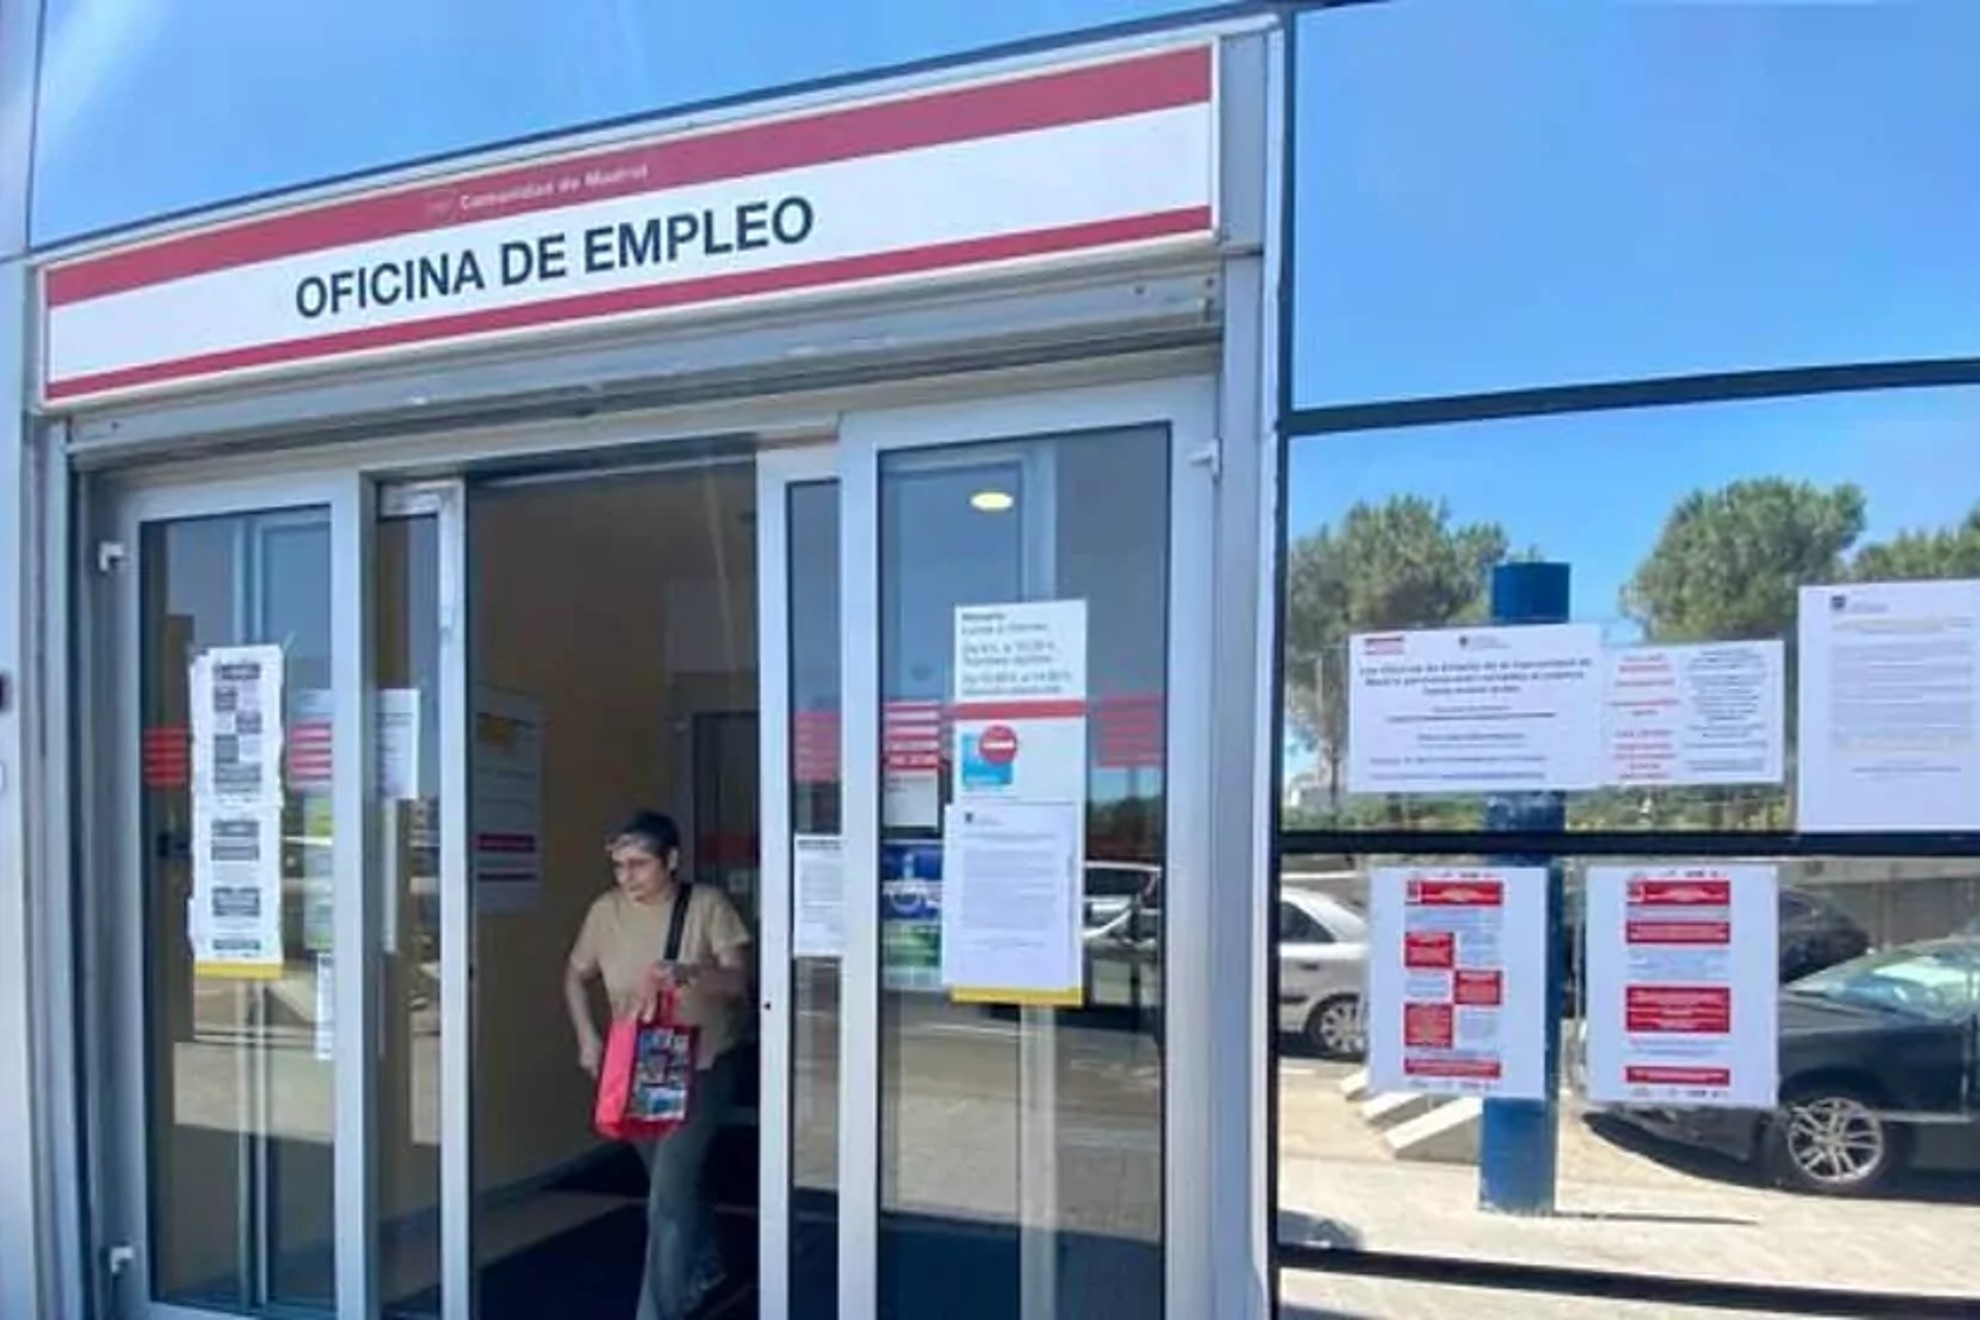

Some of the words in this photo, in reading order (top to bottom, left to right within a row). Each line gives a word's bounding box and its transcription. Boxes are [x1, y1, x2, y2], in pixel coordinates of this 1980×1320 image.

[295, 249, 486, 318] OFICINA
[501, 233, 567, 286] DE
[585, 196, 814, 272] EMPLEO
